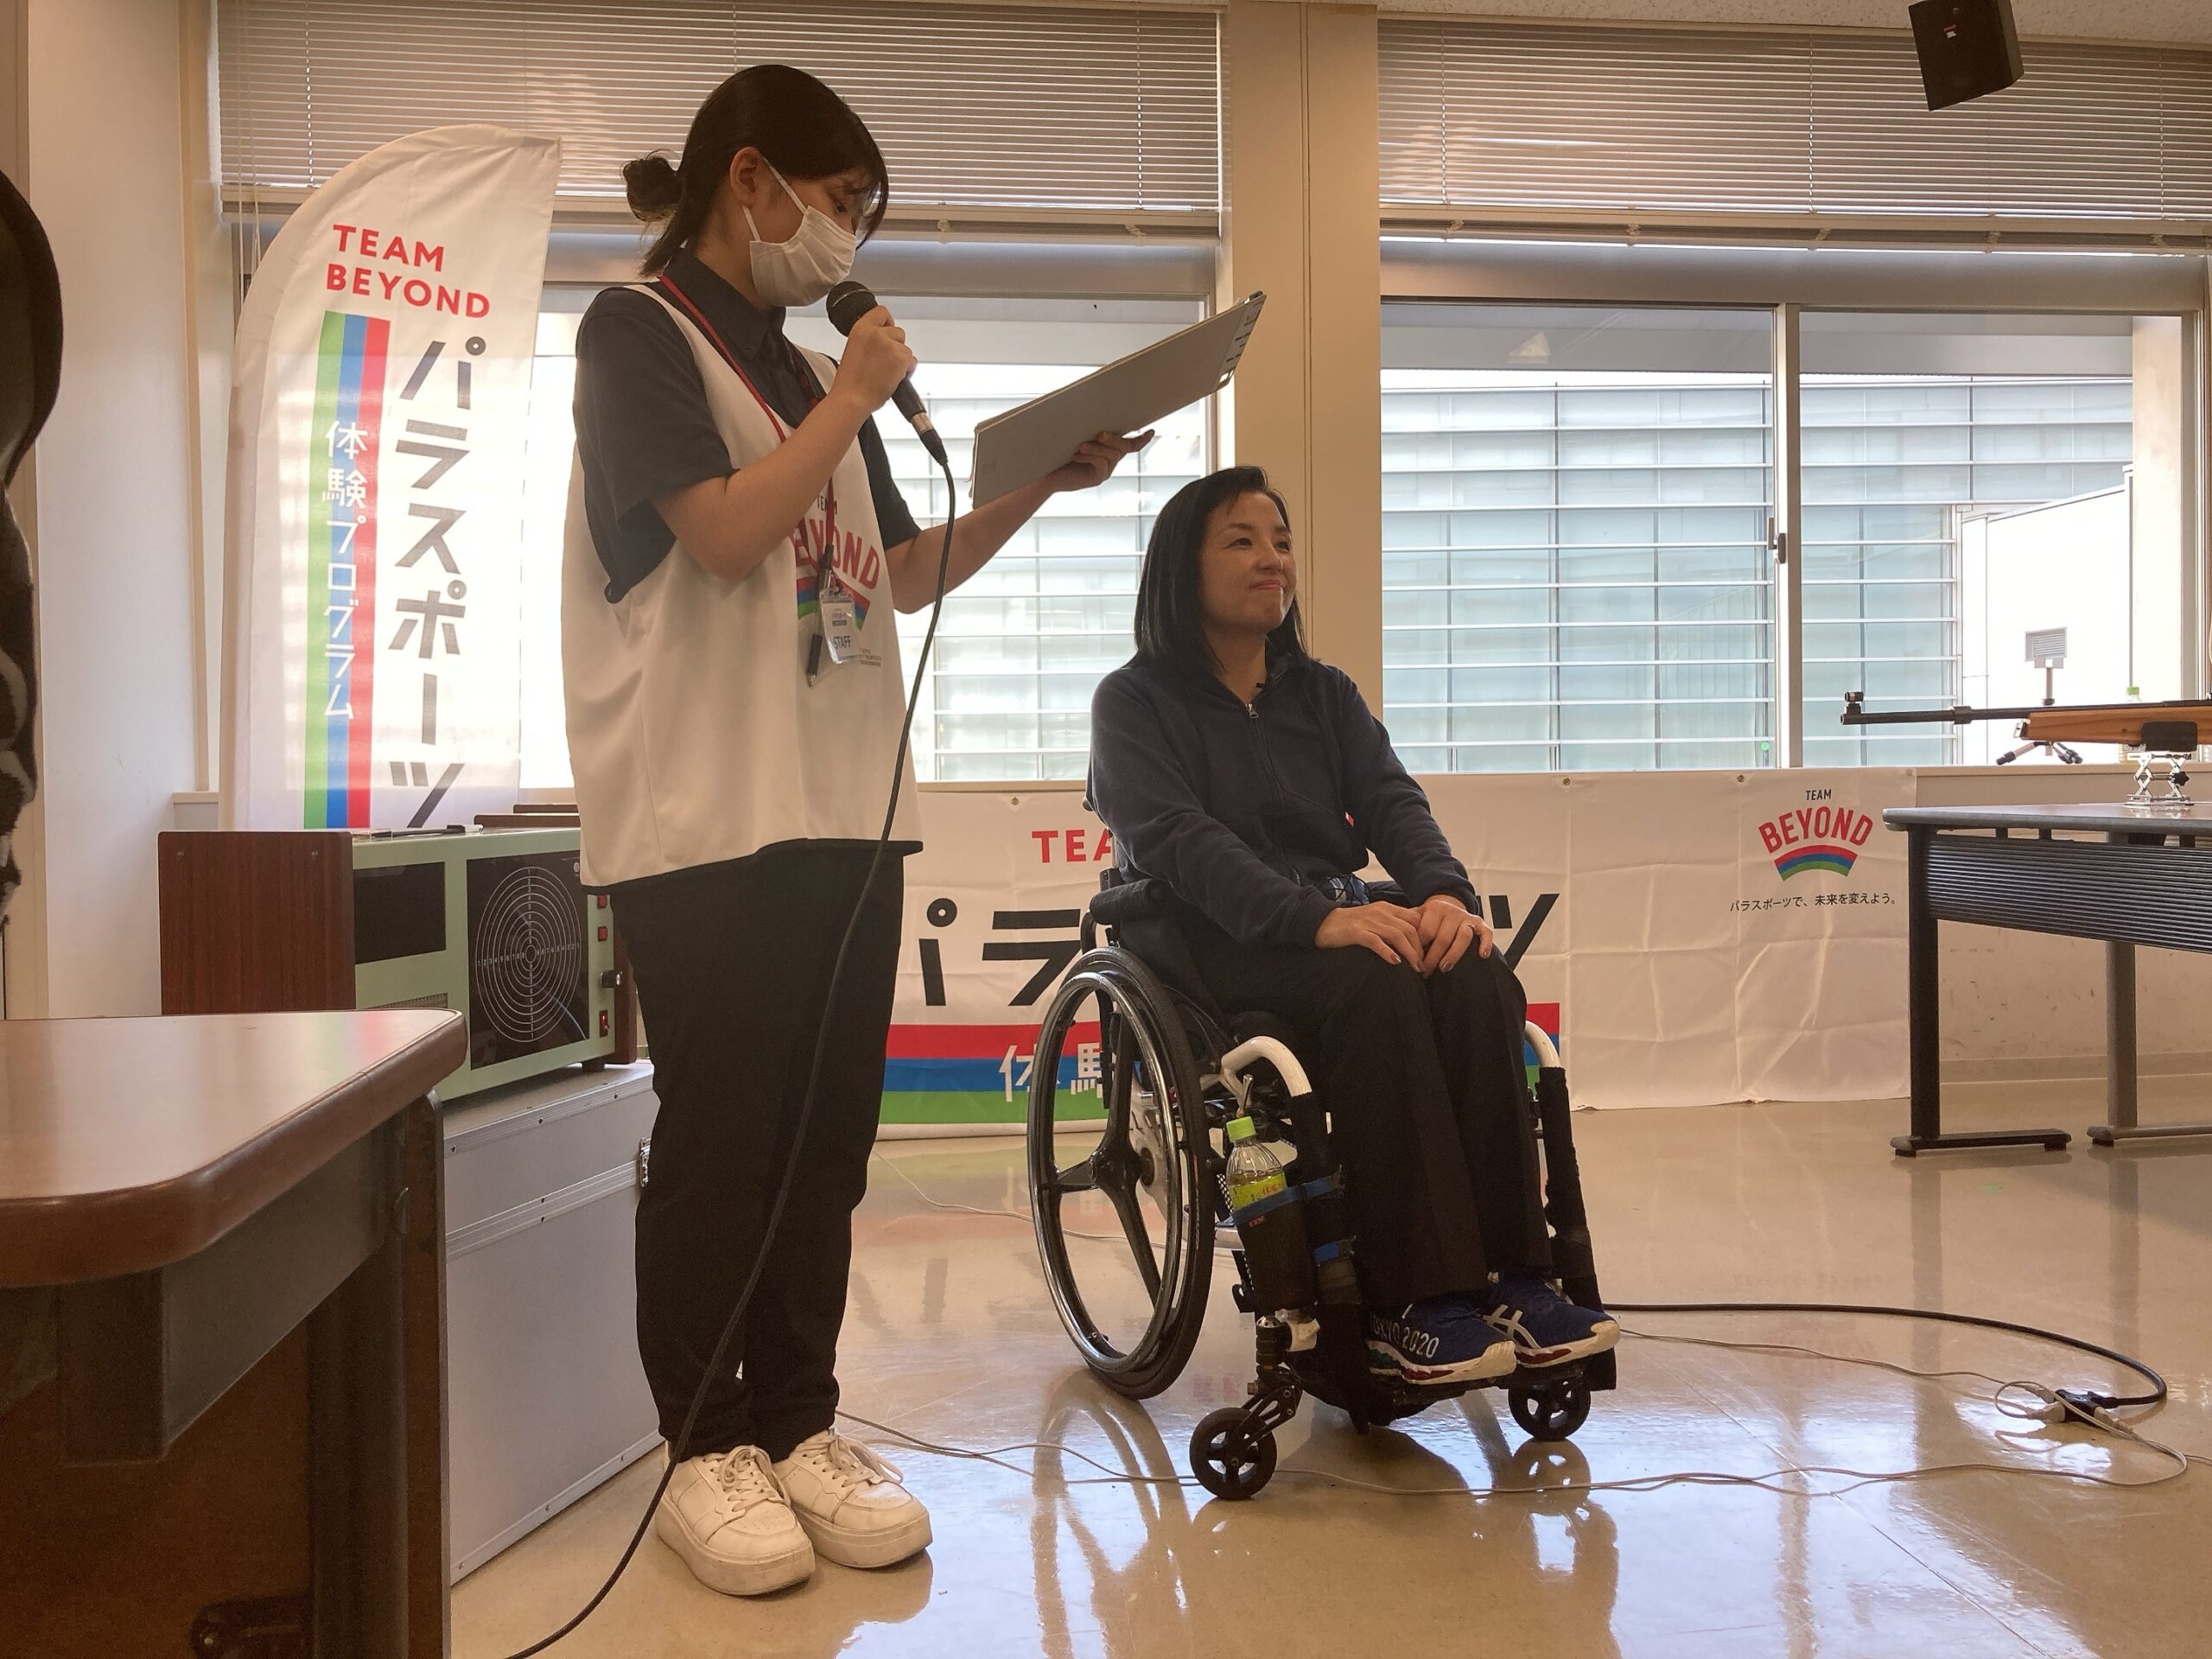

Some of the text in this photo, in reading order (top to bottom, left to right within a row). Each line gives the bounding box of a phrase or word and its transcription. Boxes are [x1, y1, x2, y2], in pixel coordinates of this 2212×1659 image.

[333, 225, 444, 272] TEAM
[327, 263, 490, 319] BEYOND
[321, 420, 369, 720] 体験プログラム
[389, 334, 486, 828] パラスポーツ
[833, 635, 851, 649] STAFF
[1805, 789, 1832, 801] TEAM
[1032, 829, 1112, 863] TEA
[1758, 806, 1873, 854] BEYOND
[1730, 893, 1896, 912] パラスポーツで、未来を変えよう。
[1402, 1326, 1440, 1358] 2020
